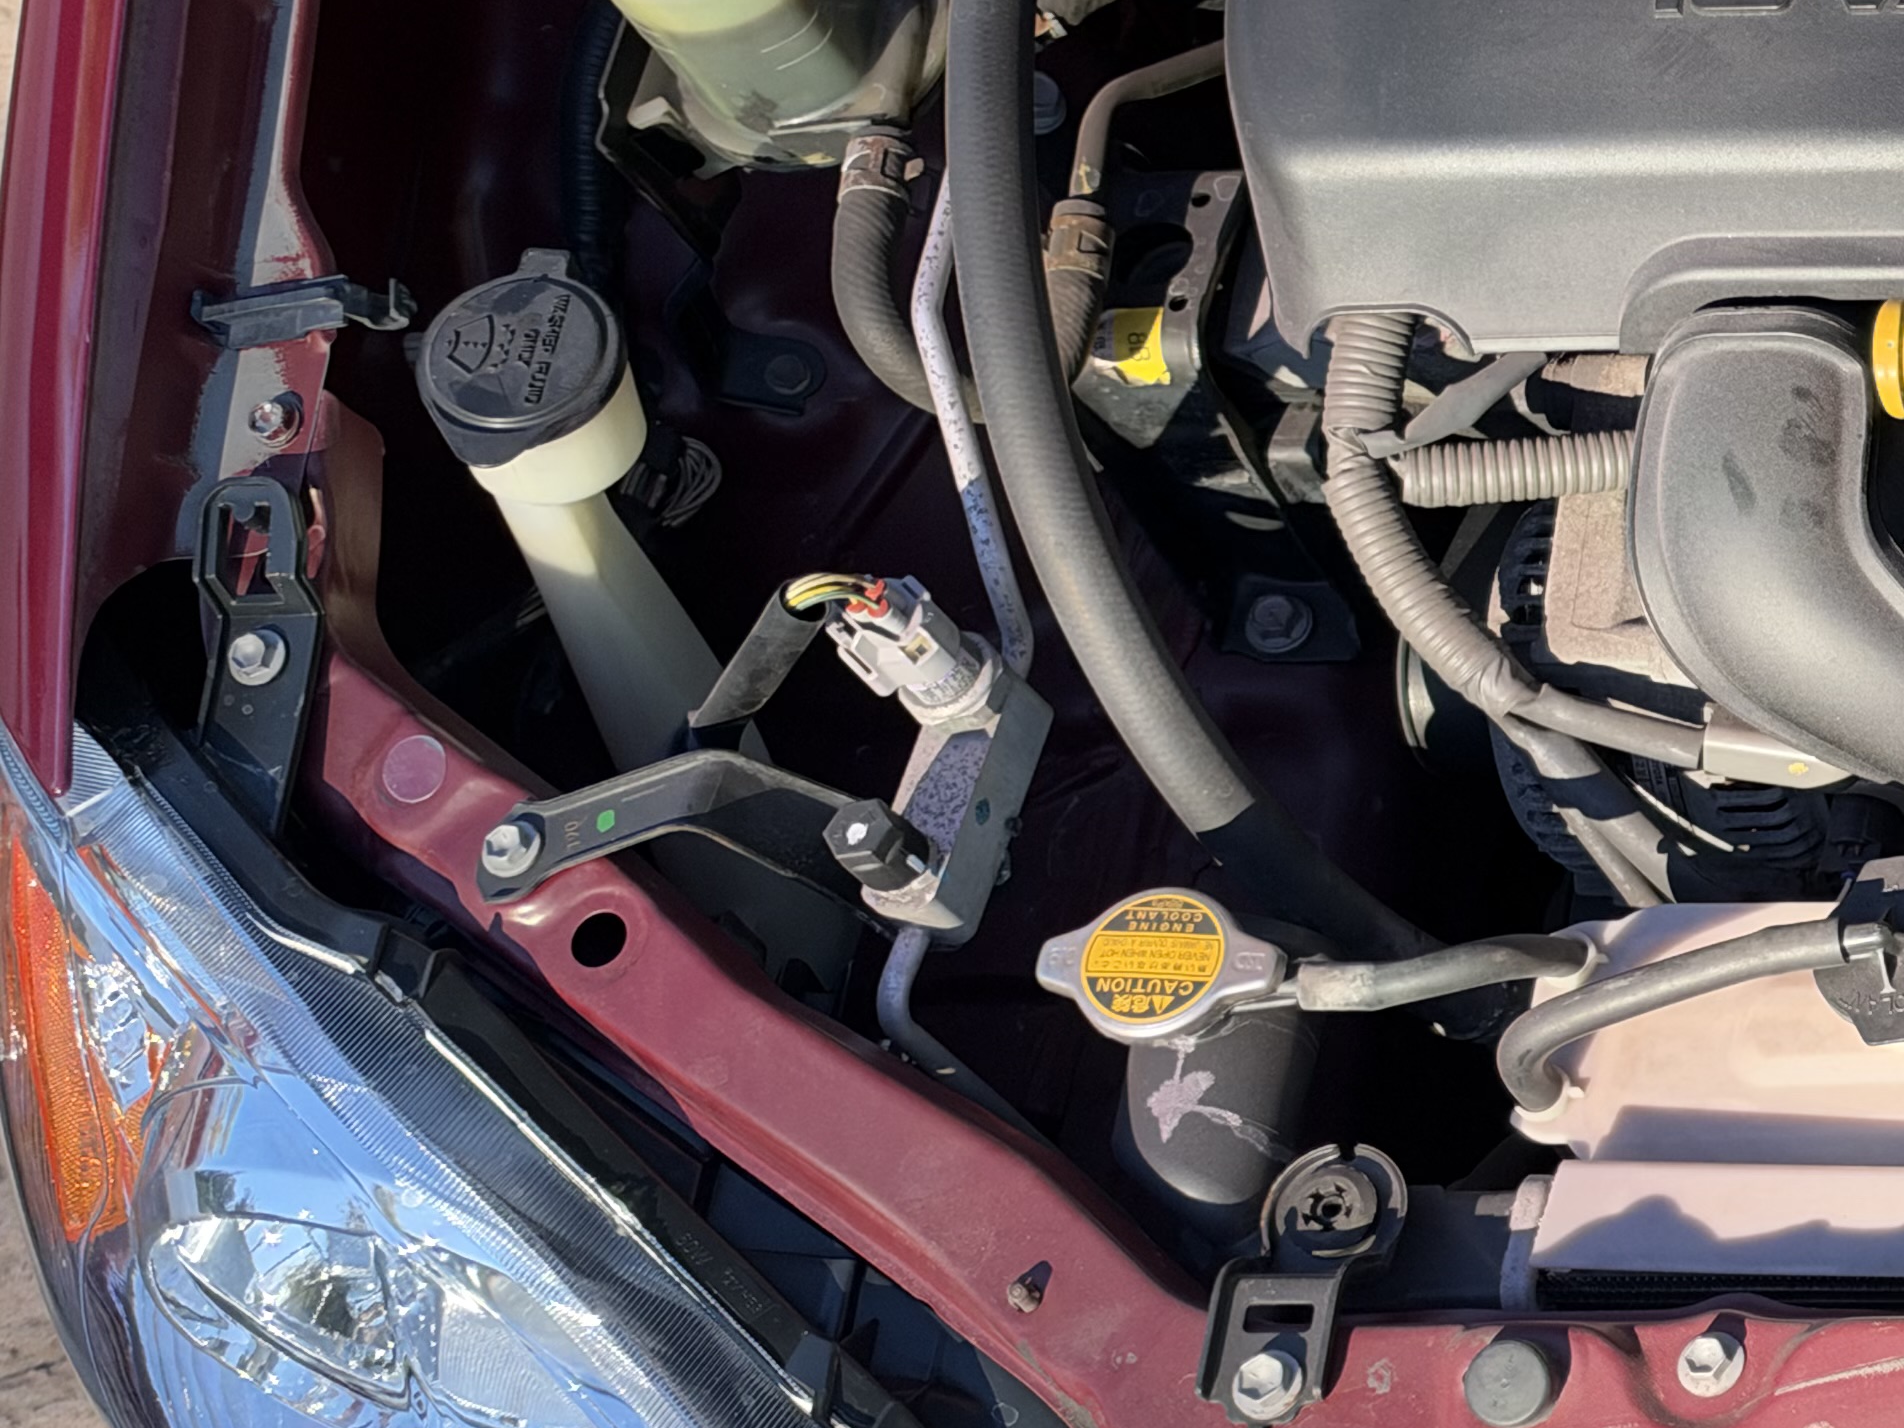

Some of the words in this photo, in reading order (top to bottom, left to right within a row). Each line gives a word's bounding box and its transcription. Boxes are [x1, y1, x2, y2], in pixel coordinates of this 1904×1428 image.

[524, 360, 553, 406] FLUID
[1125, 910, 1203, 922] COOLANT
[1128, 921, 1195, 932] ENGINE
[1096, 978, 1194, 996] CAUTION
[1111, 994, 1151, 1013] 危険
